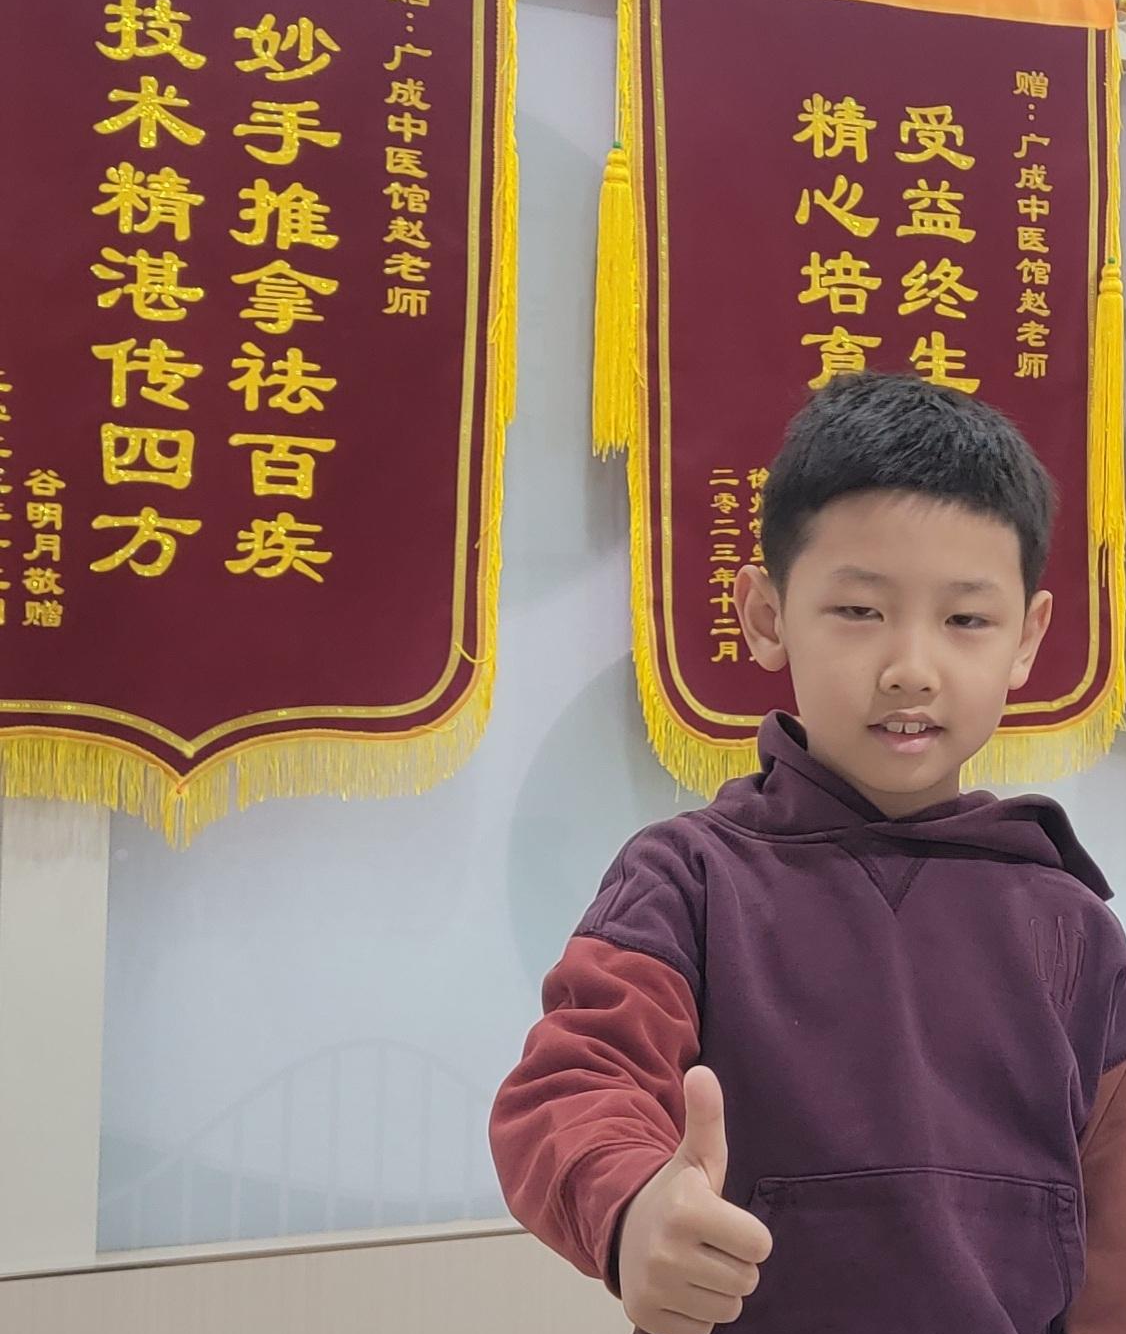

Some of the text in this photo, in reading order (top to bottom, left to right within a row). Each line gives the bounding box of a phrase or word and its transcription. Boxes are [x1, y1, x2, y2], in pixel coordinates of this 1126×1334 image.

[224, 13, 342, 584] 妙手推拿祛百疾
[894, 104, 981, 395] 受益终生
[22, 468, 66, 627] 谷明月敬赠
[708, 468, 743, 662] 二零二三年十二月
